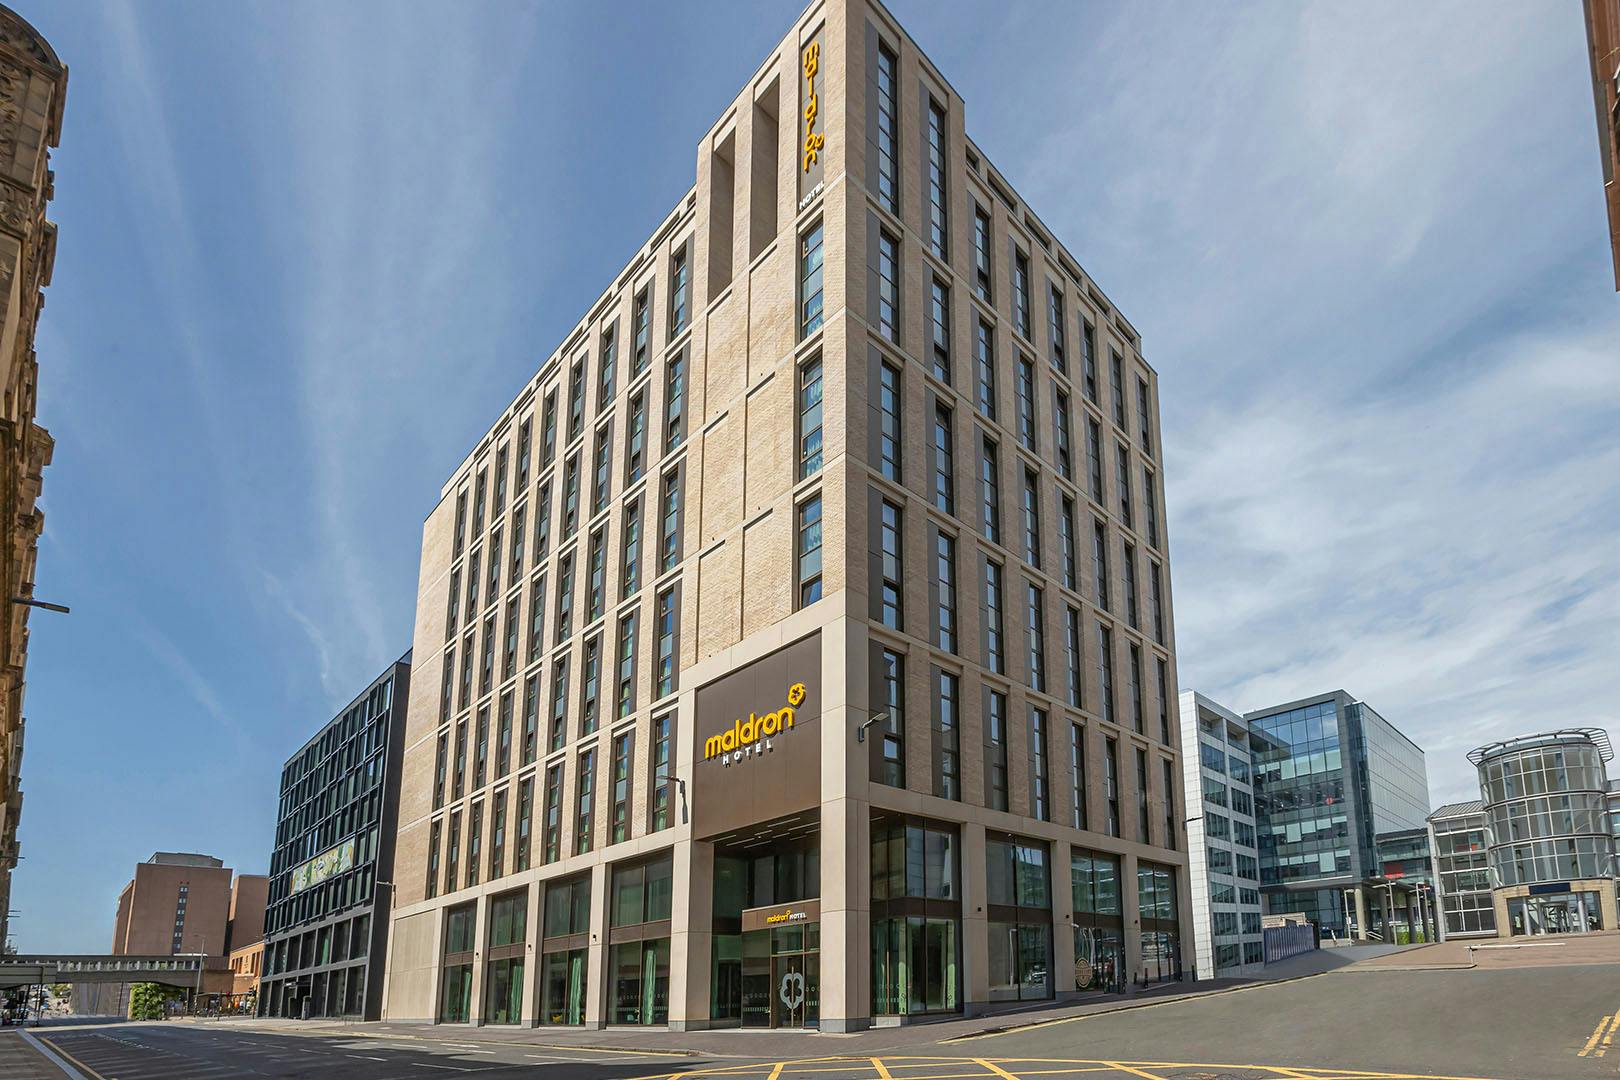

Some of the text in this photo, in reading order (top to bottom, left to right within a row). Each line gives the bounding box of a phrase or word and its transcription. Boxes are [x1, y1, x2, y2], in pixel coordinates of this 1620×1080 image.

[803, 41, 820, 172] maldron
[799, 180, 824, 210] HOTEL
[705, 706, 795, 760] maldron
[722, 740, 773, 766] HOTEL
[767, 914, 789, 923] maldron
